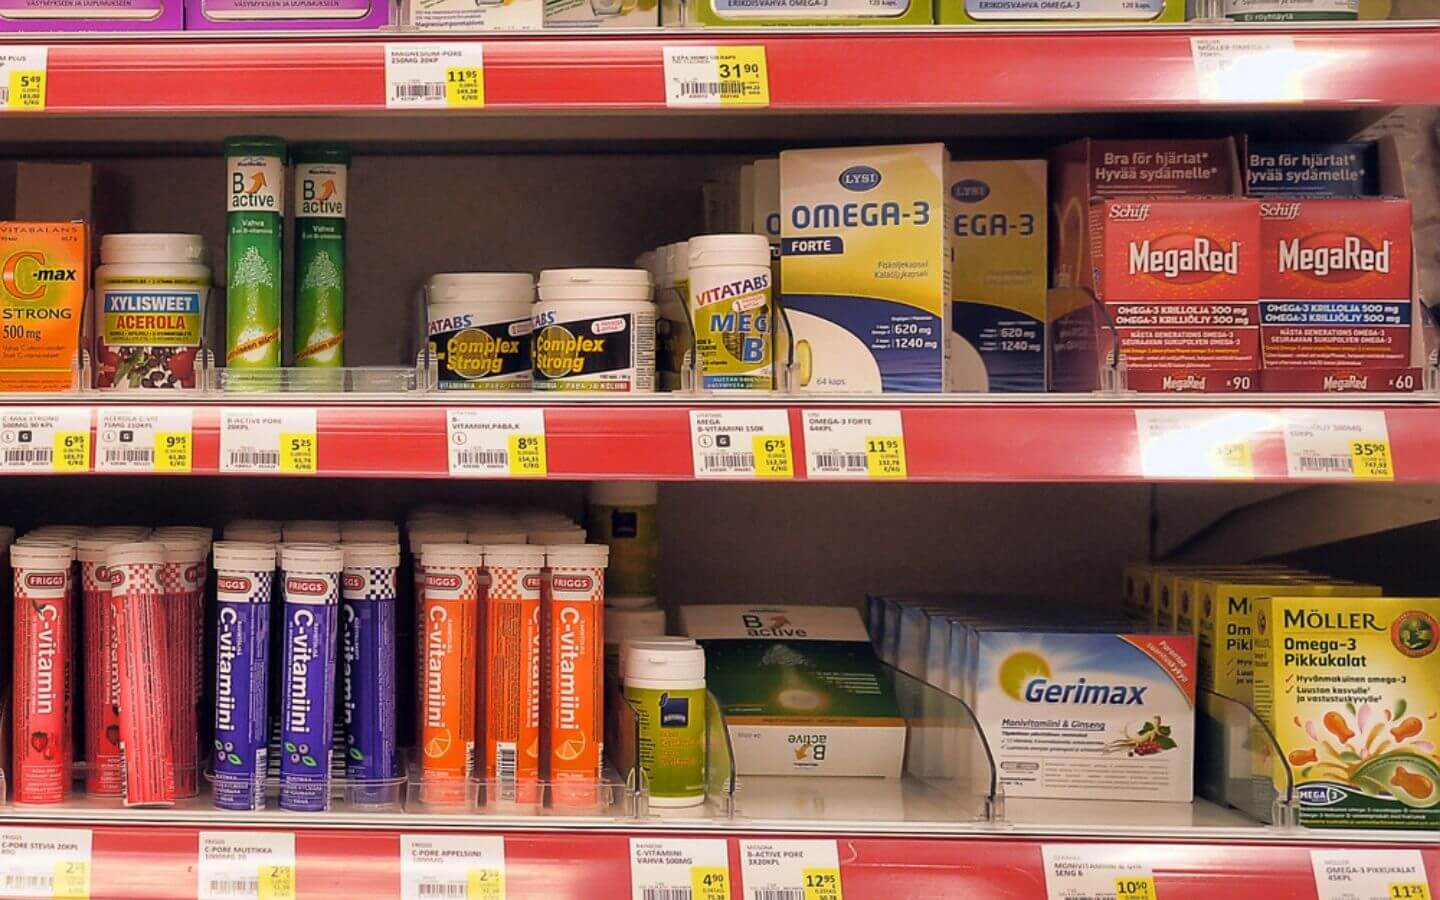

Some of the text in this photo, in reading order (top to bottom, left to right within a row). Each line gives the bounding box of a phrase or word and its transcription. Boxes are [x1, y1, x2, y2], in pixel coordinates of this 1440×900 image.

[1041, 1, 1080, 9] OMEGA-3
[1104, 152, 1129, 165] Bra
[1132, 152, 1153, 165] för
[1250, 154, 1275, 167] Bra
[1279, 154, 1300, 167] för
[843, 173, 876, 184] LYSI
[1096, 168, 1137, 183] Hyvää
[232, 172, 245, 194] B
[303, 180, 315, 200] B
[232, 193, 274, 207] active
[303, 200, 342, 214] active
[791, 201, 930, 229] OMEGA-3
[1109, 204, 1151, 220] Schiff
[1259, 203, 1300, 219] Schiff
[954, 214, 1034, 236] EGA-3
[791, 239, 831, 251] FORTE
[1129, 237, 1238, 277] MegaRed
[1279, 236, 1390, 276] MegaRed
[2, 251, 76, 301] C-max
[695, 274, 769, 306] VITATABS
[110, 296, 192, 311] XYLISWEET
[1384, 306, 1399, 314] mg
[2, 308, 72, 319] STRONG
[1233, 307, 1247, 316] mg
[116, 315, 186, 329] ACEROLA
[1235, 317, 1249, 325] mg
[3, 325, 41, 341] 500 mg
[894, 324, 931, 336] 620 mg
[447, 338, 519, 354] Complex
[536, 336, 604, 353] Complex
[742, 336, 765, 363] B
[895, 338, 938, 350] 1240 mg
[447, 355, 503, 373] Strong
[1163, 376, 1206, 390] MegaRed
[1324, 376, 1367, 390] MegaRed
[30, 576, 63, 585] FRIGGS
[742, 615, 763, 628] B
[1284, 609, 1387, 631] MÖLLER
[747, 626, 807, 638] active
[1284, 638, 1357, 653] Omega-3
[37, 604, 57, 714] C-vitamin
[1284, 653, 1366, 667] Pikkukalat
[218, 607, 237, 731] C-vitamiini
[290, 609, 313, 733] C-vitamiini
[428, 605, 447, 728] C-vitamiini
[560, 607, 580, 729] C-vitamiini
[1296, 674, 1407, 685] Hyvänmakuinen omega-3
[1025, 677, 1147, 705] Gerimax
[1296, 686, 1329, 694] Luuston
[1296, 695, 1306, 704] ja
[1071, 719, 1106, 731] Ginseng
[787, 735, 827, 746] active
